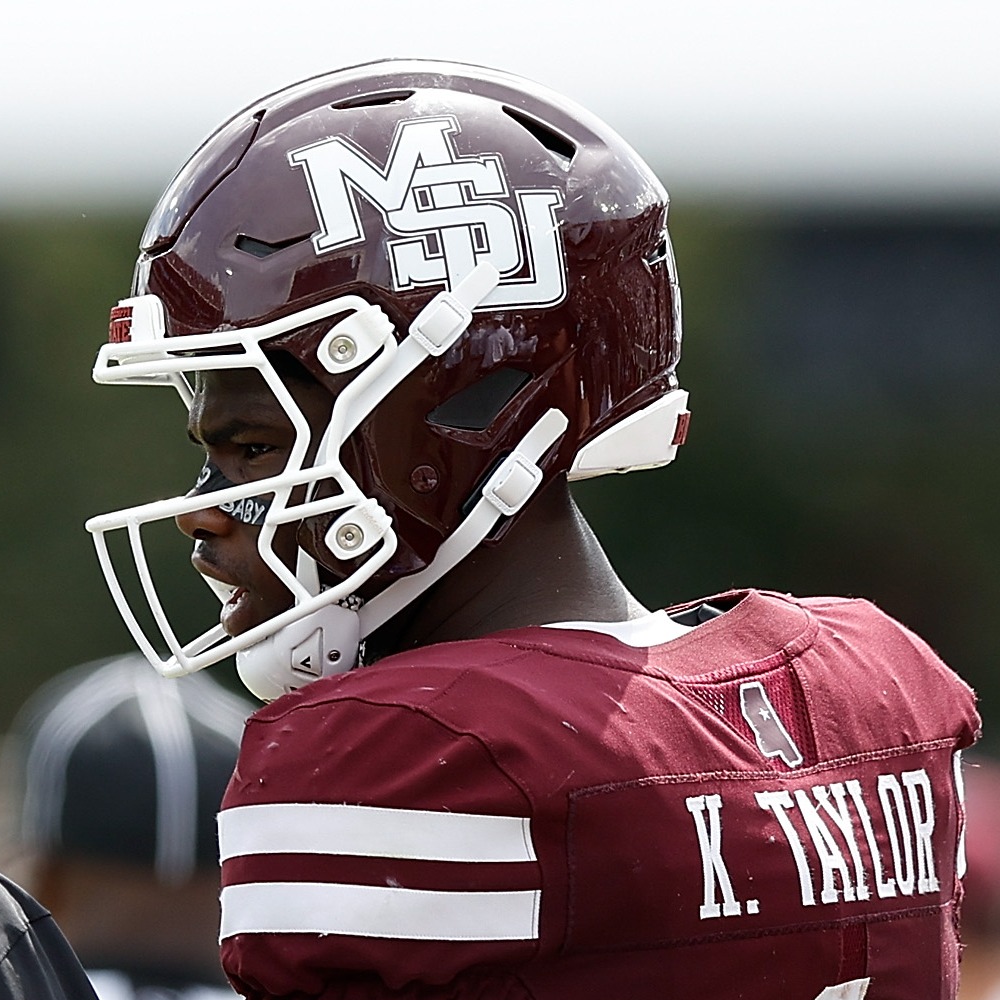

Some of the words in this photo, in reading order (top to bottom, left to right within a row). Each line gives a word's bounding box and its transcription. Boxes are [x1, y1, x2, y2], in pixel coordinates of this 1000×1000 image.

[288, 115, 567, 312] MSU
[686, 795, 759, 919] K.
[755, 769, 940, 906] TAYLOR
